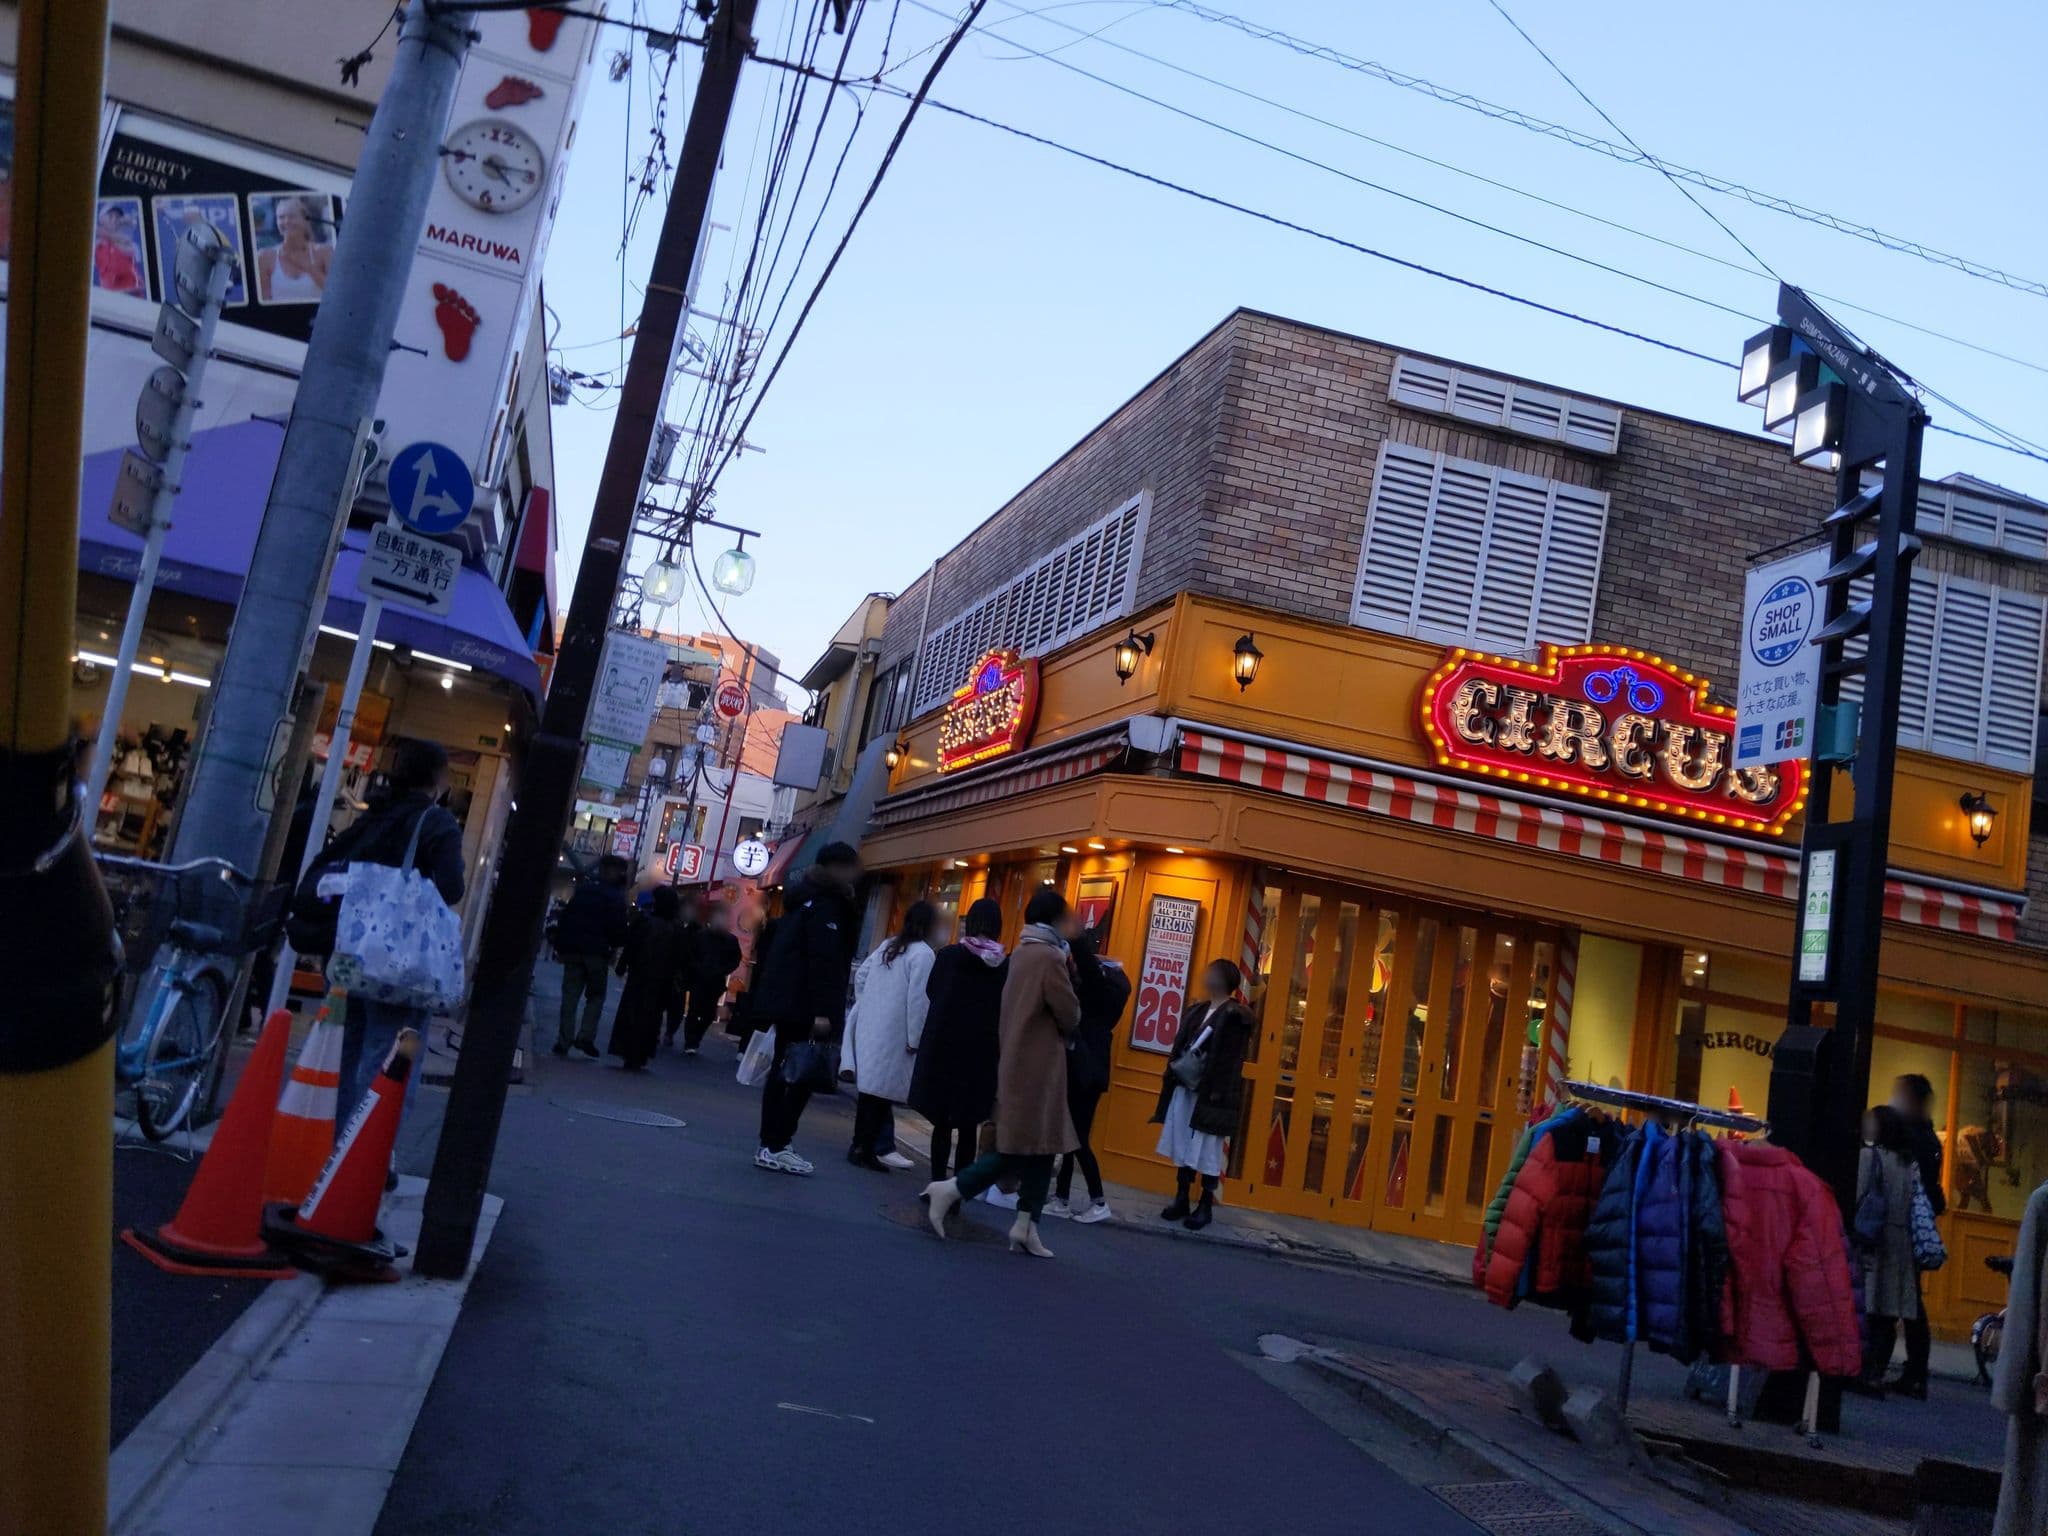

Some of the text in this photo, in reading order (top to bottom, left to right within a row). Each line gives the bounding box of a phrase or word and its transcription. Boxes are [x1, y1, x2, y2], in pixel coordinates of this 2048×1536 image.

[489, 128, 515, 147] 12
[116, 147, 191, 180] LIBERTY
[112, 164, 168, 191] CROSS
[480, 190, 493, 209] 6
[427, 224, 520, 264] MARUWA
[376, 531, 456, 570] 自転車を除く
[371, 556, 453, 591] 一方通行
[1765, 602, 1801, 625] SHOP
[1759, 617, 1802, 642] SMALL
[1743, 671, 1810, 699] 小さな買い物、
[1744, 690, 1802, 717] 大きな応援。
[1776, 727, 1803, 742] JCB
[741, 846, 763, 868] 芋
[1152, 915, 1194, 934] CIRCUS
[1159, 908, 1191, 919] ALL-STAR
[1149, 957, 1184, 974] FRIDAY
[1143, 972, 1185, 990] JAN.
[1134, 986, 1182, 1046] 26
[1704, 1032, 1773, 1060] CIRCU
